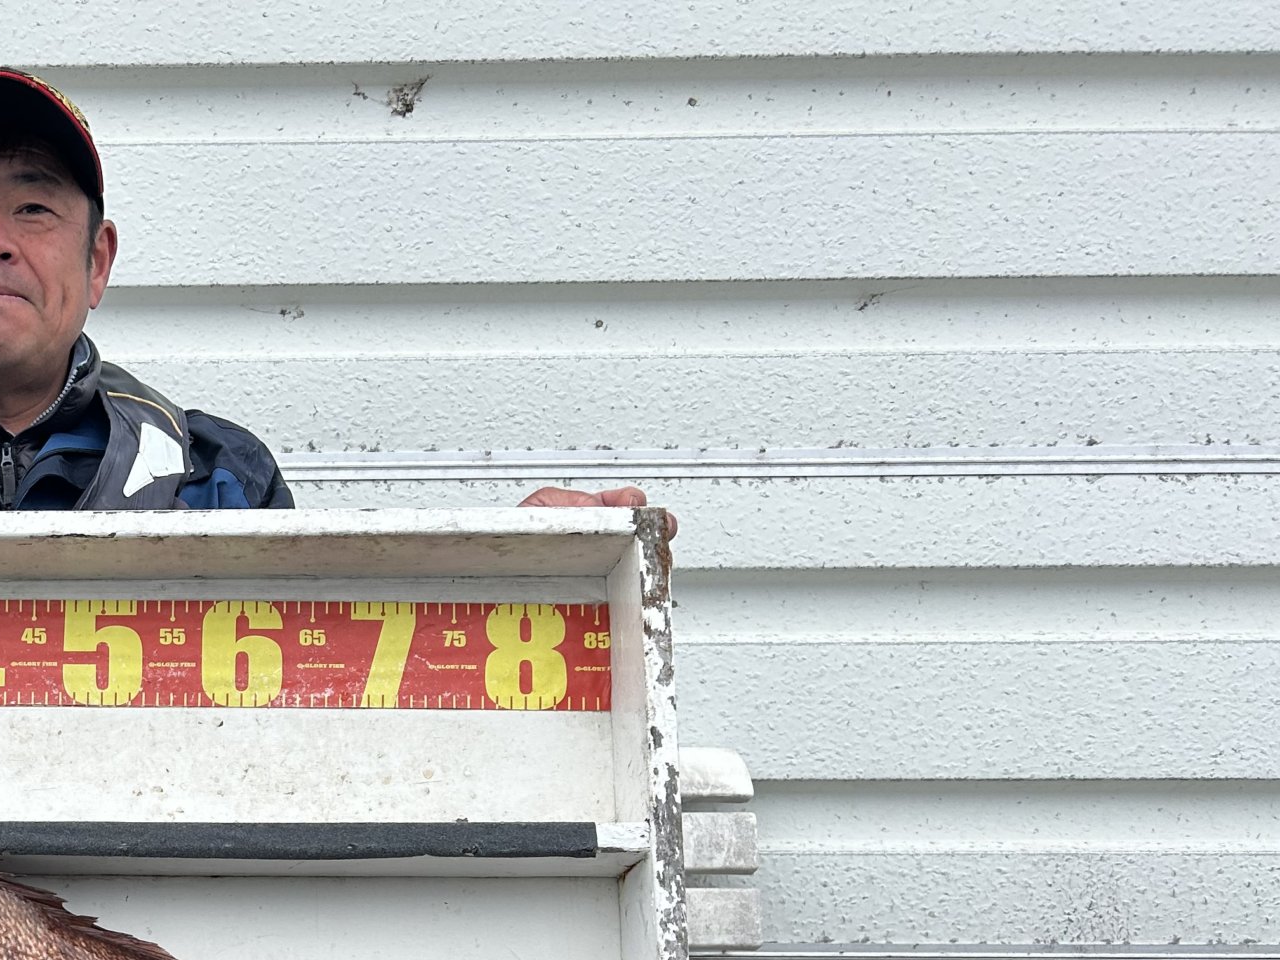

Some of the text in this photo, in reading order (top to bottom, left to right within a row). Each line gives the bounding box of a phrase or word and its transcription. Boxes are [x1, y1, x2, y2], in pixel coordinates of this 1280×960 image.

[21, 627, 47, 645] 45
[62, 600, 143, 706] 5
[159, 628, 186, 645] 55
[202, 600, 283, 707] 6
[299, 629, 326, 647] 65
[351, 602, 416, 708] 7
[443, 630, 466, 648] 75
[485, 603, 568, 710] 8
[583, 632, 611, 649] 85
